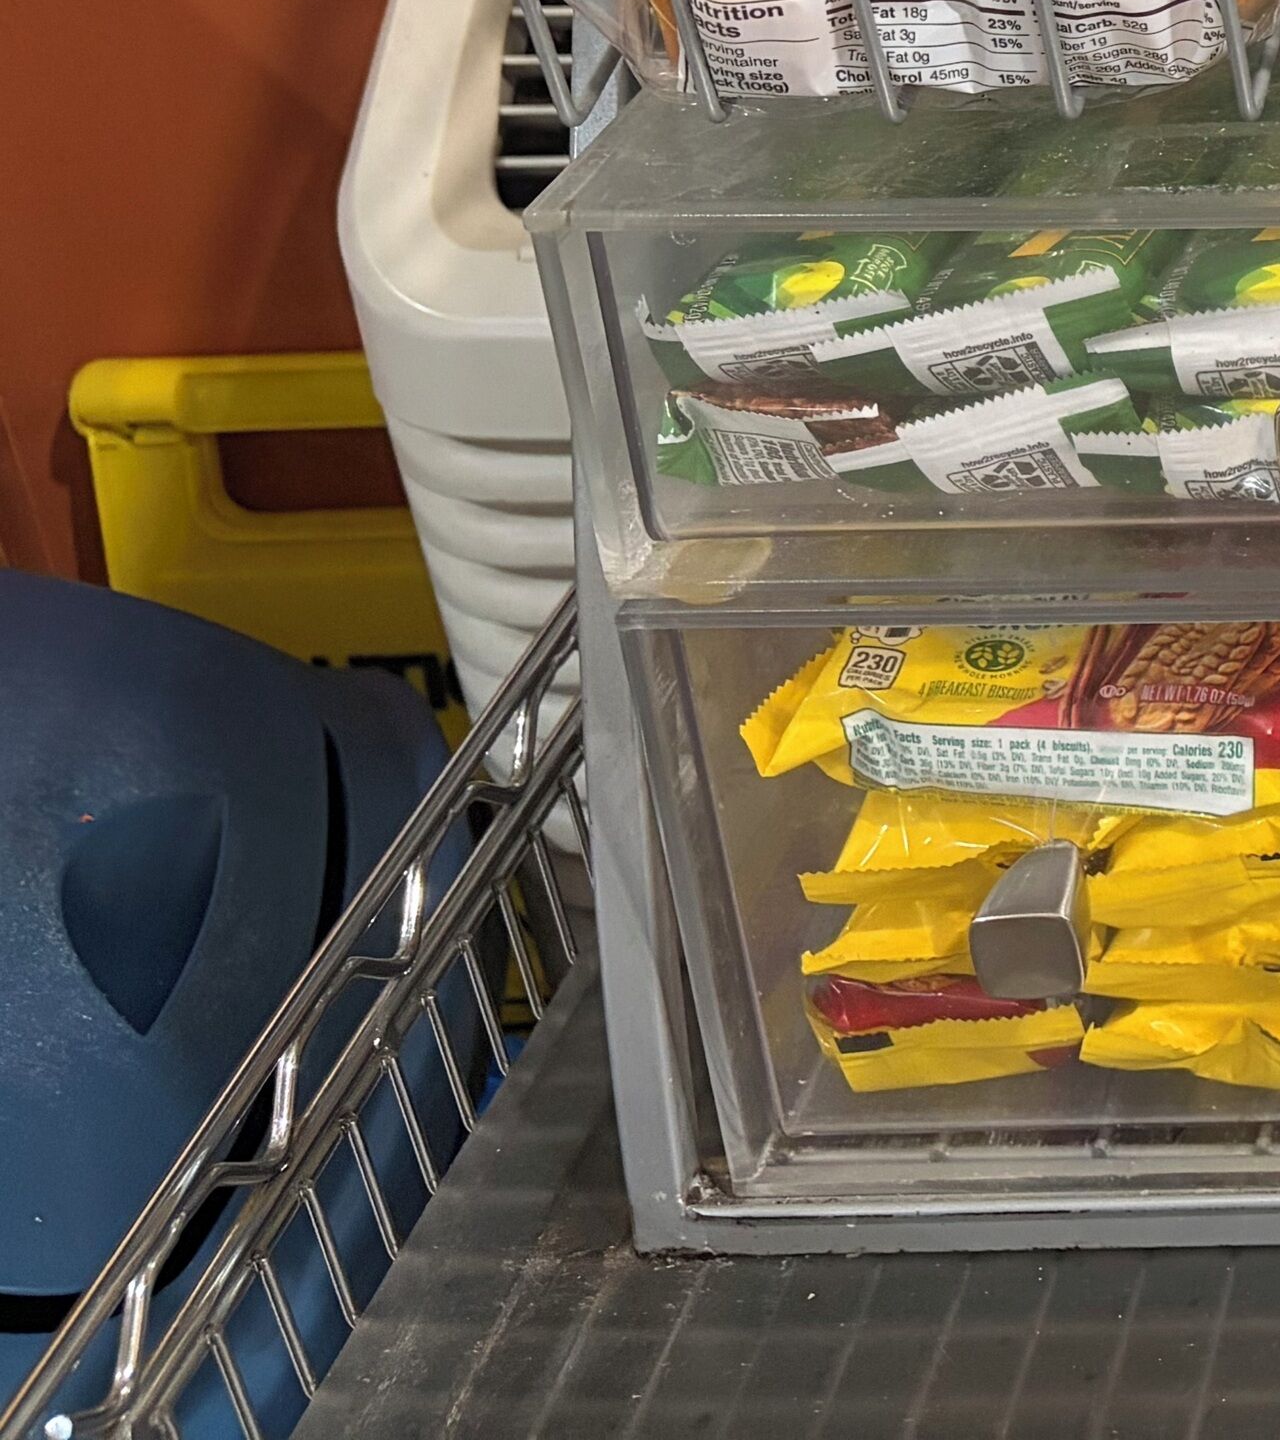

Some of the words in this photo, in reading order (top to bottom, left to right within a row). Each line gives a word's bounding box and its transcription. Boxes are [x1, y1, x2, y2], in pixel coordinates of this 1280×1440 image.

[696, 16, 741, 38] acts
[902, 7, 929, 21] 18g
[988, 17, 1022, 31] 23%
[1076, 18, 1116, 34] Carb.
[1122, 18, 1149, 33] 52g
[843, 29, 862, 41] Sa
[900, 29, 916, 43] 3g
[990, 37, 1023, 50] 15%
[1060, 37, 1086, 52] iber
[1090, 36, 1108, 49] 1g
[708, 52, 779, 68] container
[848, 49, 868, 62] Tra
[886, 51, 908, 64] Fat
[912, 51, 930, 65] 0g
[1092, 48, 1141, 62] Sugars
[1124, 60, 1165, 74] Added
[749, 70, 783, 82] size
[835, 69, 923, 84] Cholterol
[929, 68, 969, 82] 45mg
[998, 73, 1030, 85] 15%
[738, 78, 790, 94] (106g)
[942, 332, 1034, 360] how2recycle.info
[855, 651, 898, 674] 230
[918, 685, 926, 698] 4
[926, 680, 986, 698] BREAKFAST
[989, 683, 1036, 700] BISCUITS
[1141, 685, 1162, 701] NET
[1165, 685, 1182, 702] WT
[1185, 686, 1207, 703] 1.76
[1211, 689, 1225, 704] OZ
[894, 730, 922, 745] Facts
[932, 735, 966, 748] Serving
[971, 736, 993, 748] size:
[1009, 739, 1031, 751] pack
[1172, 743, 1214, 758] Calories
[1217, 741, 1244, 759] 230
